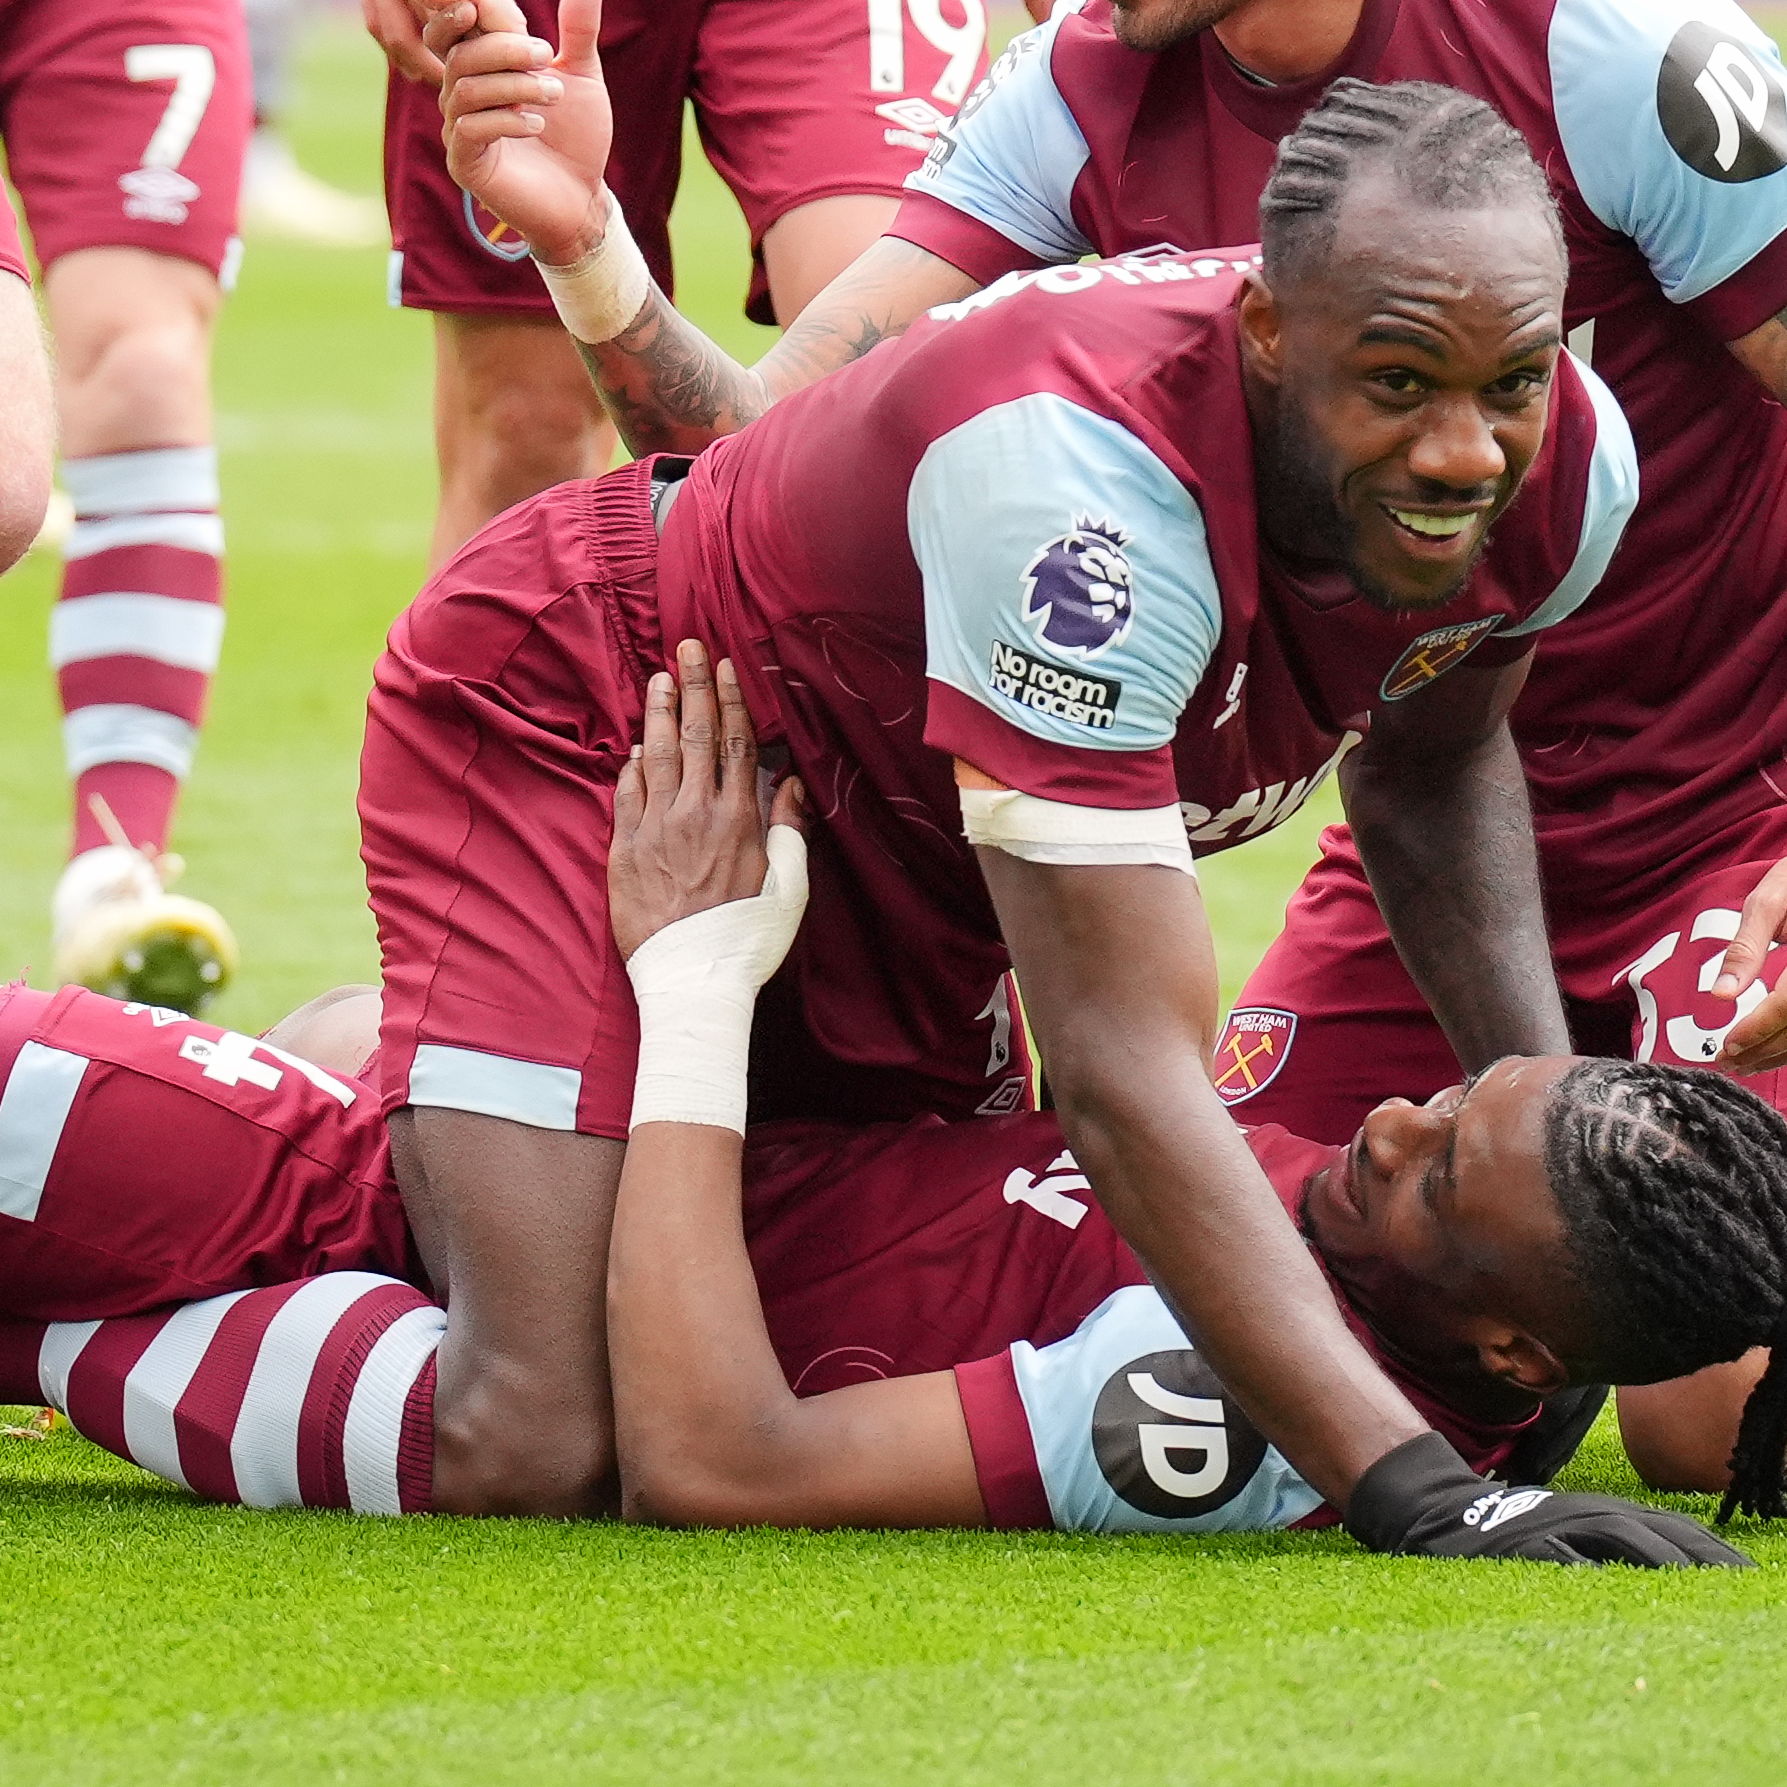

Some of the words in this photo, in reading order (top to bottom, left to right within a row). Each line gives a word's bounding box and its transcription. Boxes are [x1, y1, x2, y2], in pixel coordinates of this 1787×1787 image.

[124, 43, 216, 169] 7
[1694, 41, 1769, 172] JD
[989, 665, 1023, 699] for
[1022, 684, 1114, 729] racism
[991, 640, 1028, 678] No
[1028, 662, 1108, 706] room
[1232, 1013, 1260, 1027] WEST
[1259, 1014, 1287, 1029] HAM
[1238, 1023, 1273, 1033] UNITED
[1127, 1373, 1229, 1498] JD
